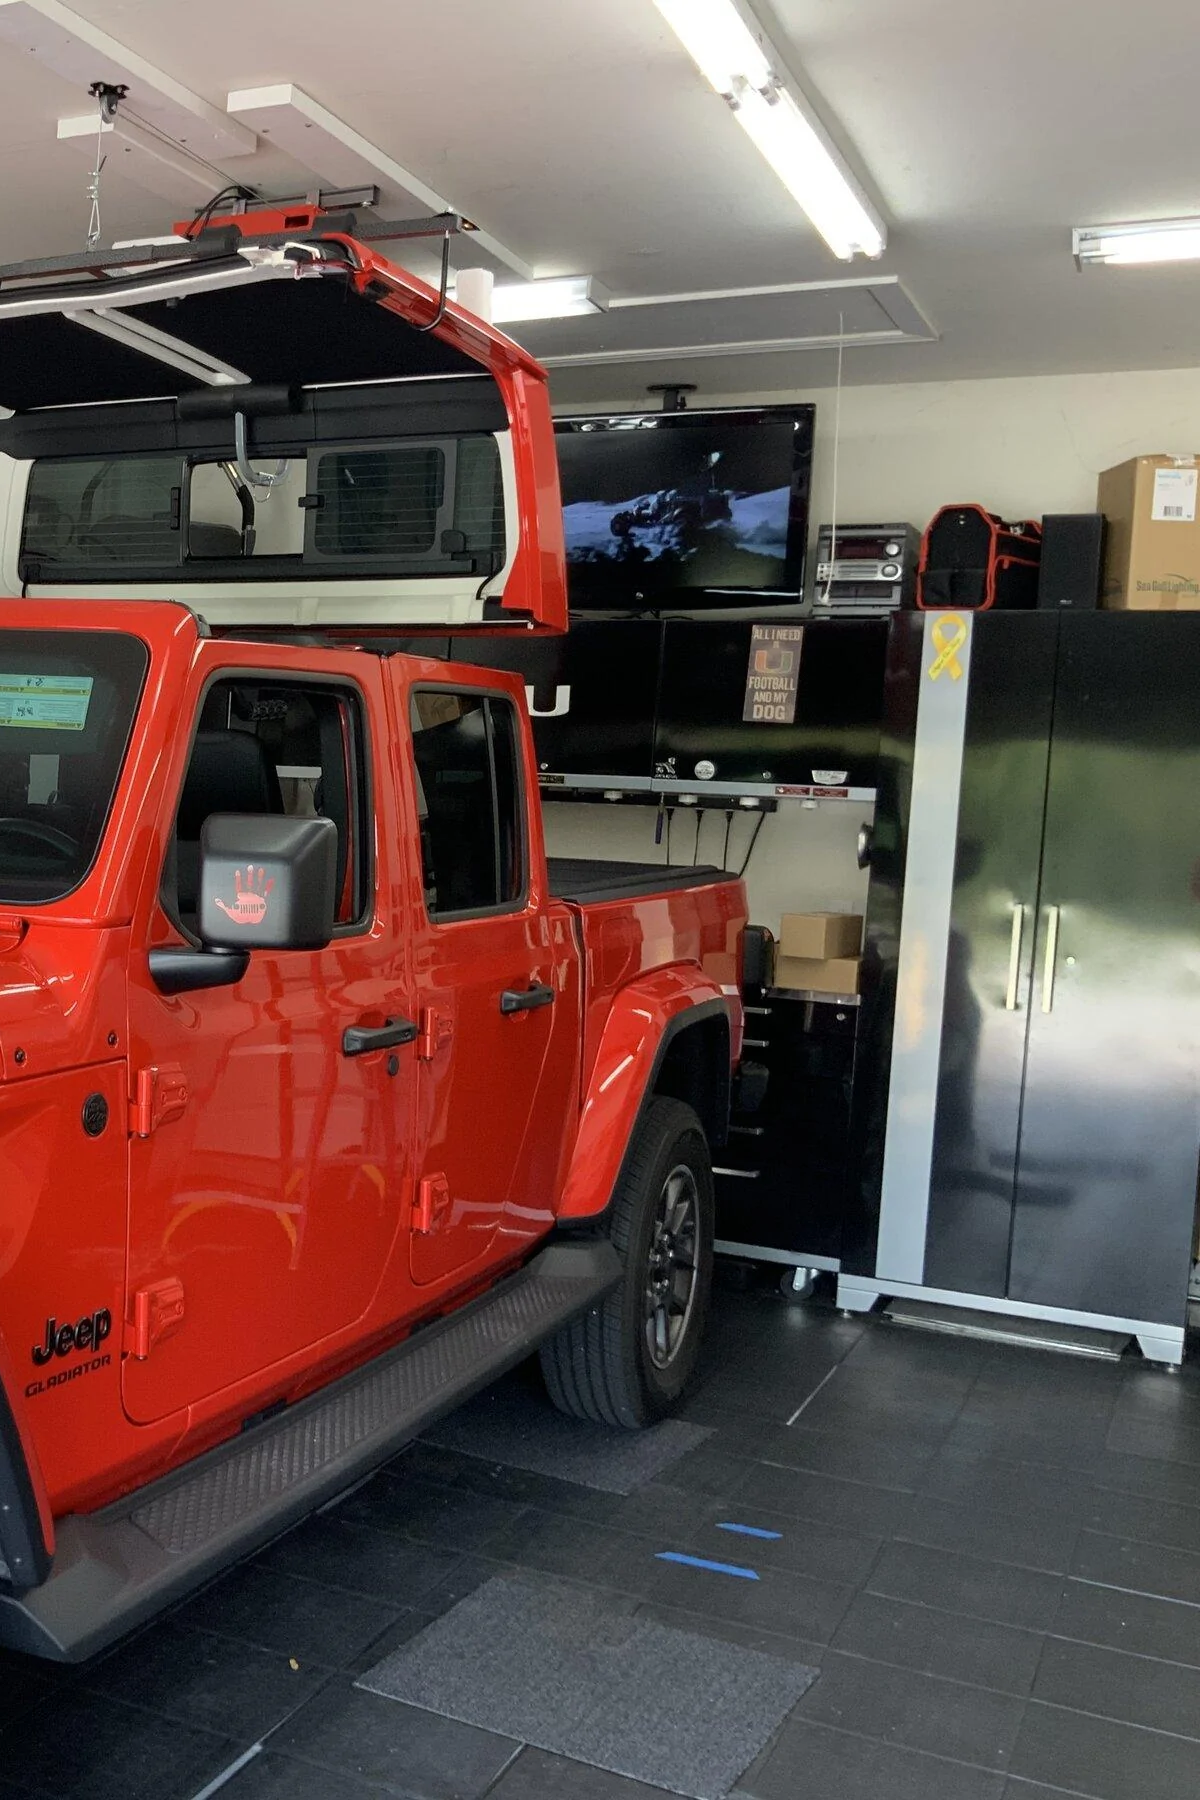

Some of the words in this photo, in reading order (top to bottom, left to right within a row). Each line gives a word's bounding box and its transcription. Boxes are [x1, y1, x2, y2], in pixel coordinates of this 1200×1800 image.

[753, 628, 769, 640] ALL
[776, 629, 800, 641] NEED
[748, 676, 795, 691] FOOTBALL
[753, 691, 772, 703] AND
[773, 692, 788, 703] MY
[752, 704, 786, 720] DOG
[31, 1307, 112, 1366] Jeep
[24, 1354, 111, 1398] GLADIATOR
